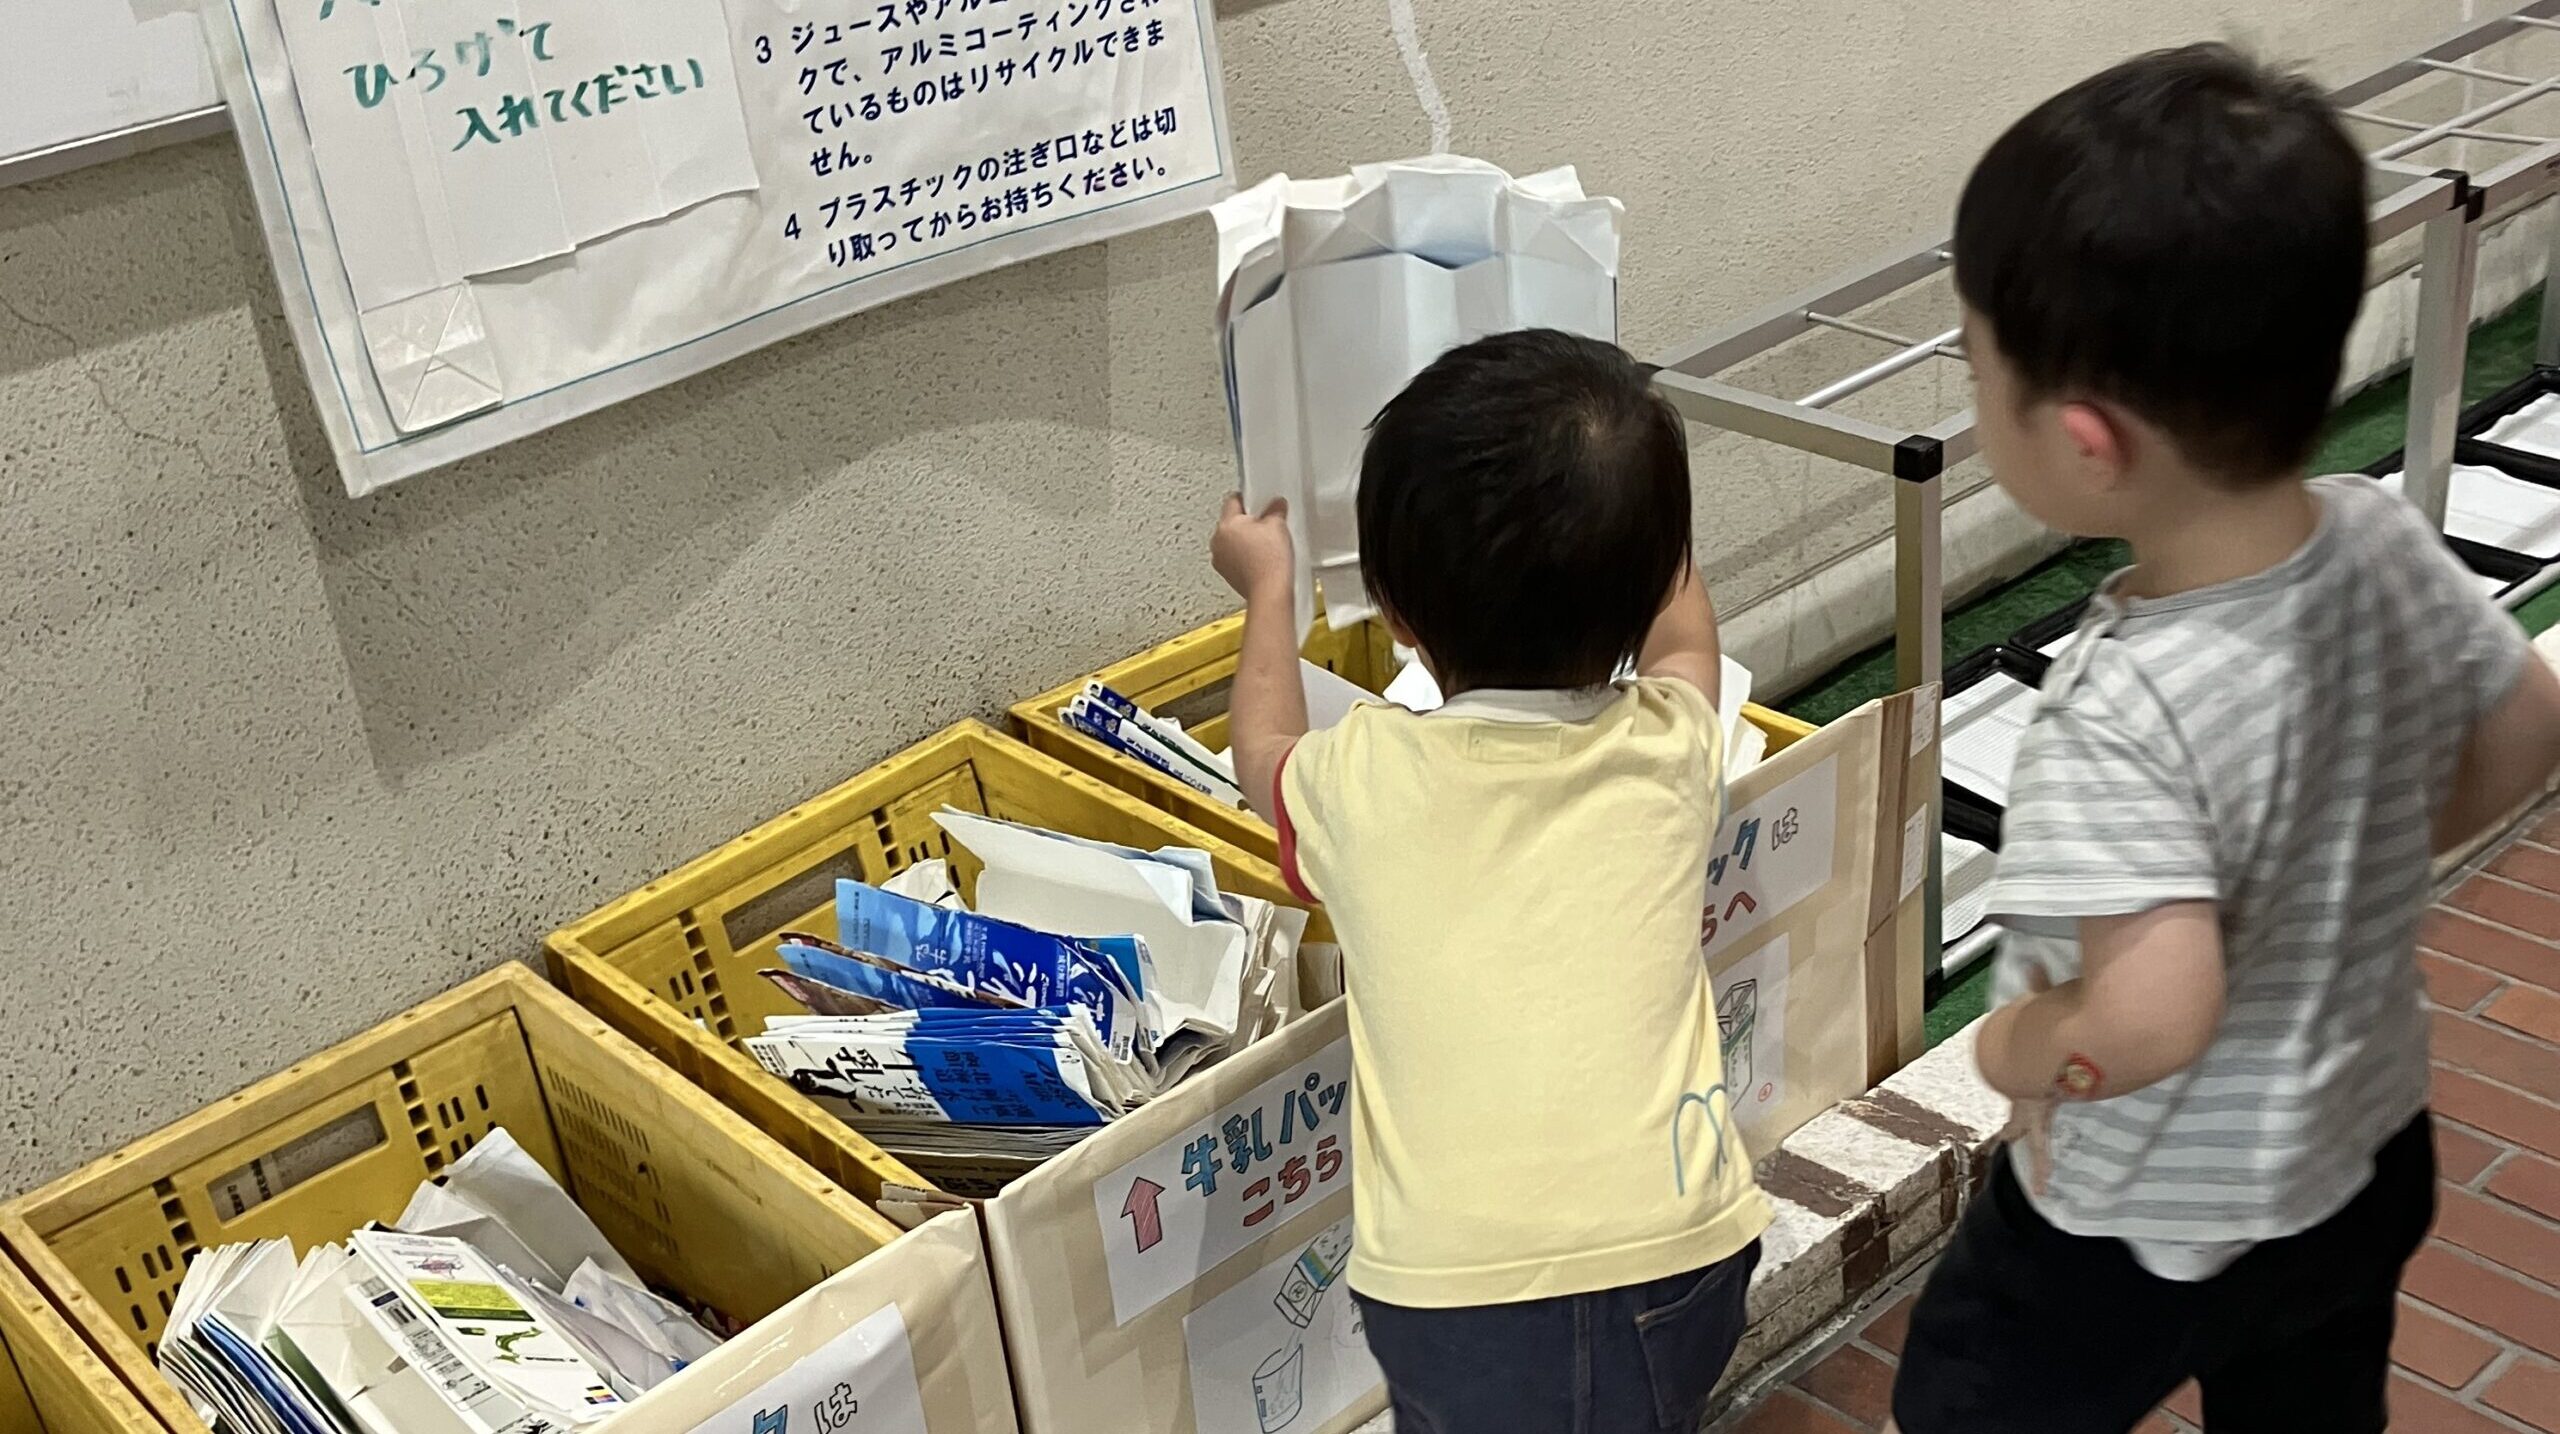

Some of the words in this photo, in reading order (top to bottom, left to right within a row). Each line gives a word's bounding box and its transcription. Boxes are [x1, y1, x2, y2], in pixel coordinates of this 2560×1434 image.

[342, 18, 554, 108] ひろげて
[755, 35, 773, 64] 3
[791, 0, 1008, 55] ジュースやア
[798, 0, 1160, 96] クで、アルミコーティングさ
[802, 19, 1165, 134] ているものはリサイクルできま
[452, 58, 705, 152] 入れてください
[784, 212, 802, 240] 4
[819, 106, 1177, 229] プラスチックの注ぎ口などは切
[810, 141, 873, 177] せん。
[828, 156, 1166, 267] り取ってからお持ちください。
[1243, 1135, 1343, 1227] こちら
